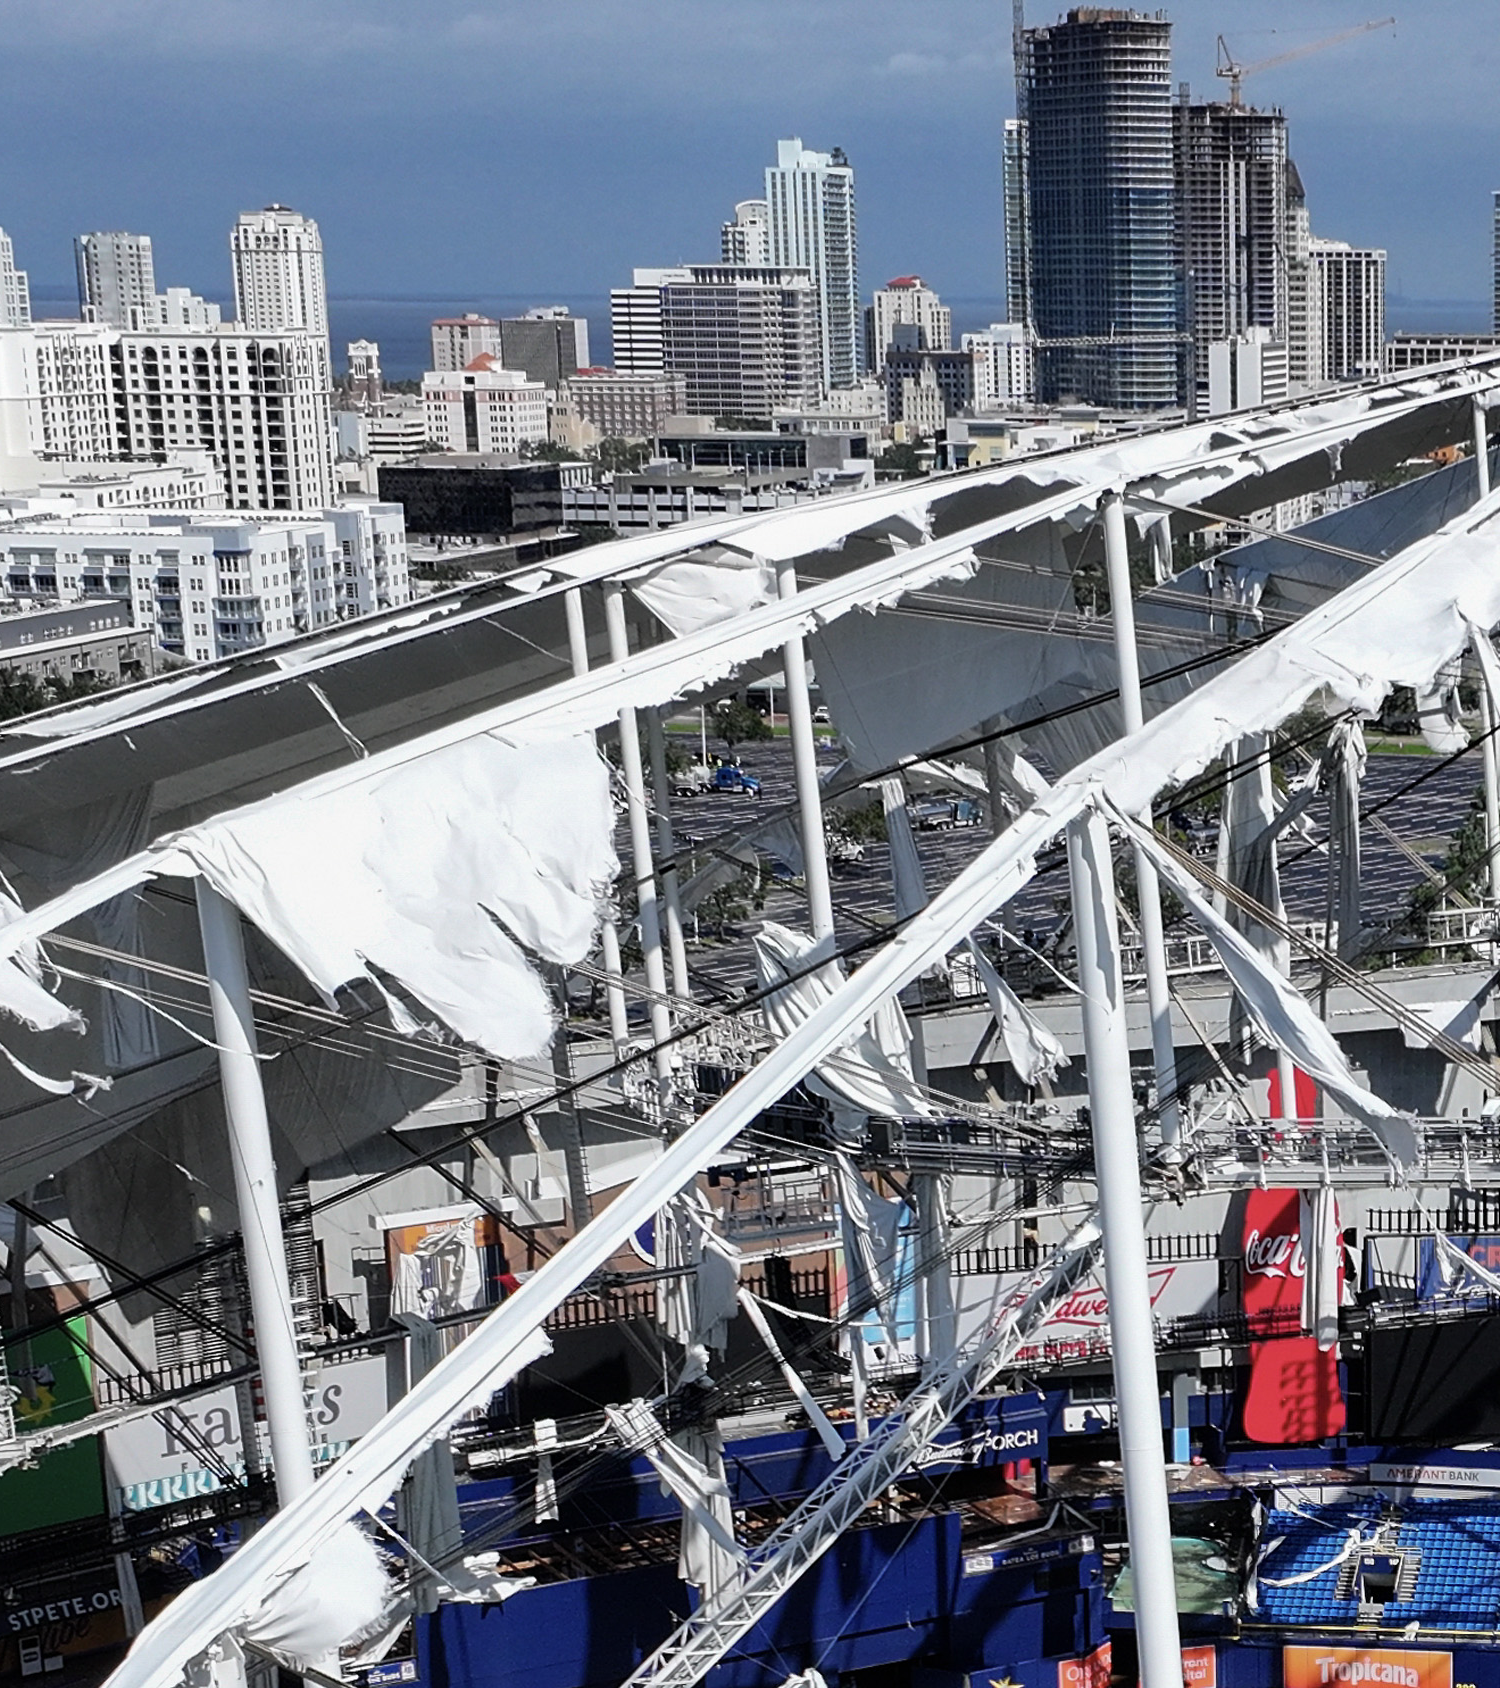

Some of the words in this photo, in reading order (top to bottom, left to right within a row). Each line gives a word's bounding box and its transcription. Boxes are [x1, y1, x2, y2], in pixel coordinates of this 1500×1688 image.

[1386, 1468, 1447, 1481] AMERANT
[1449, 1470, 1480, 1483] BANK
[7, 1588, 125, 1633] STPETE.OR
[1316, 1656, 1421, 1688] Tropicana
